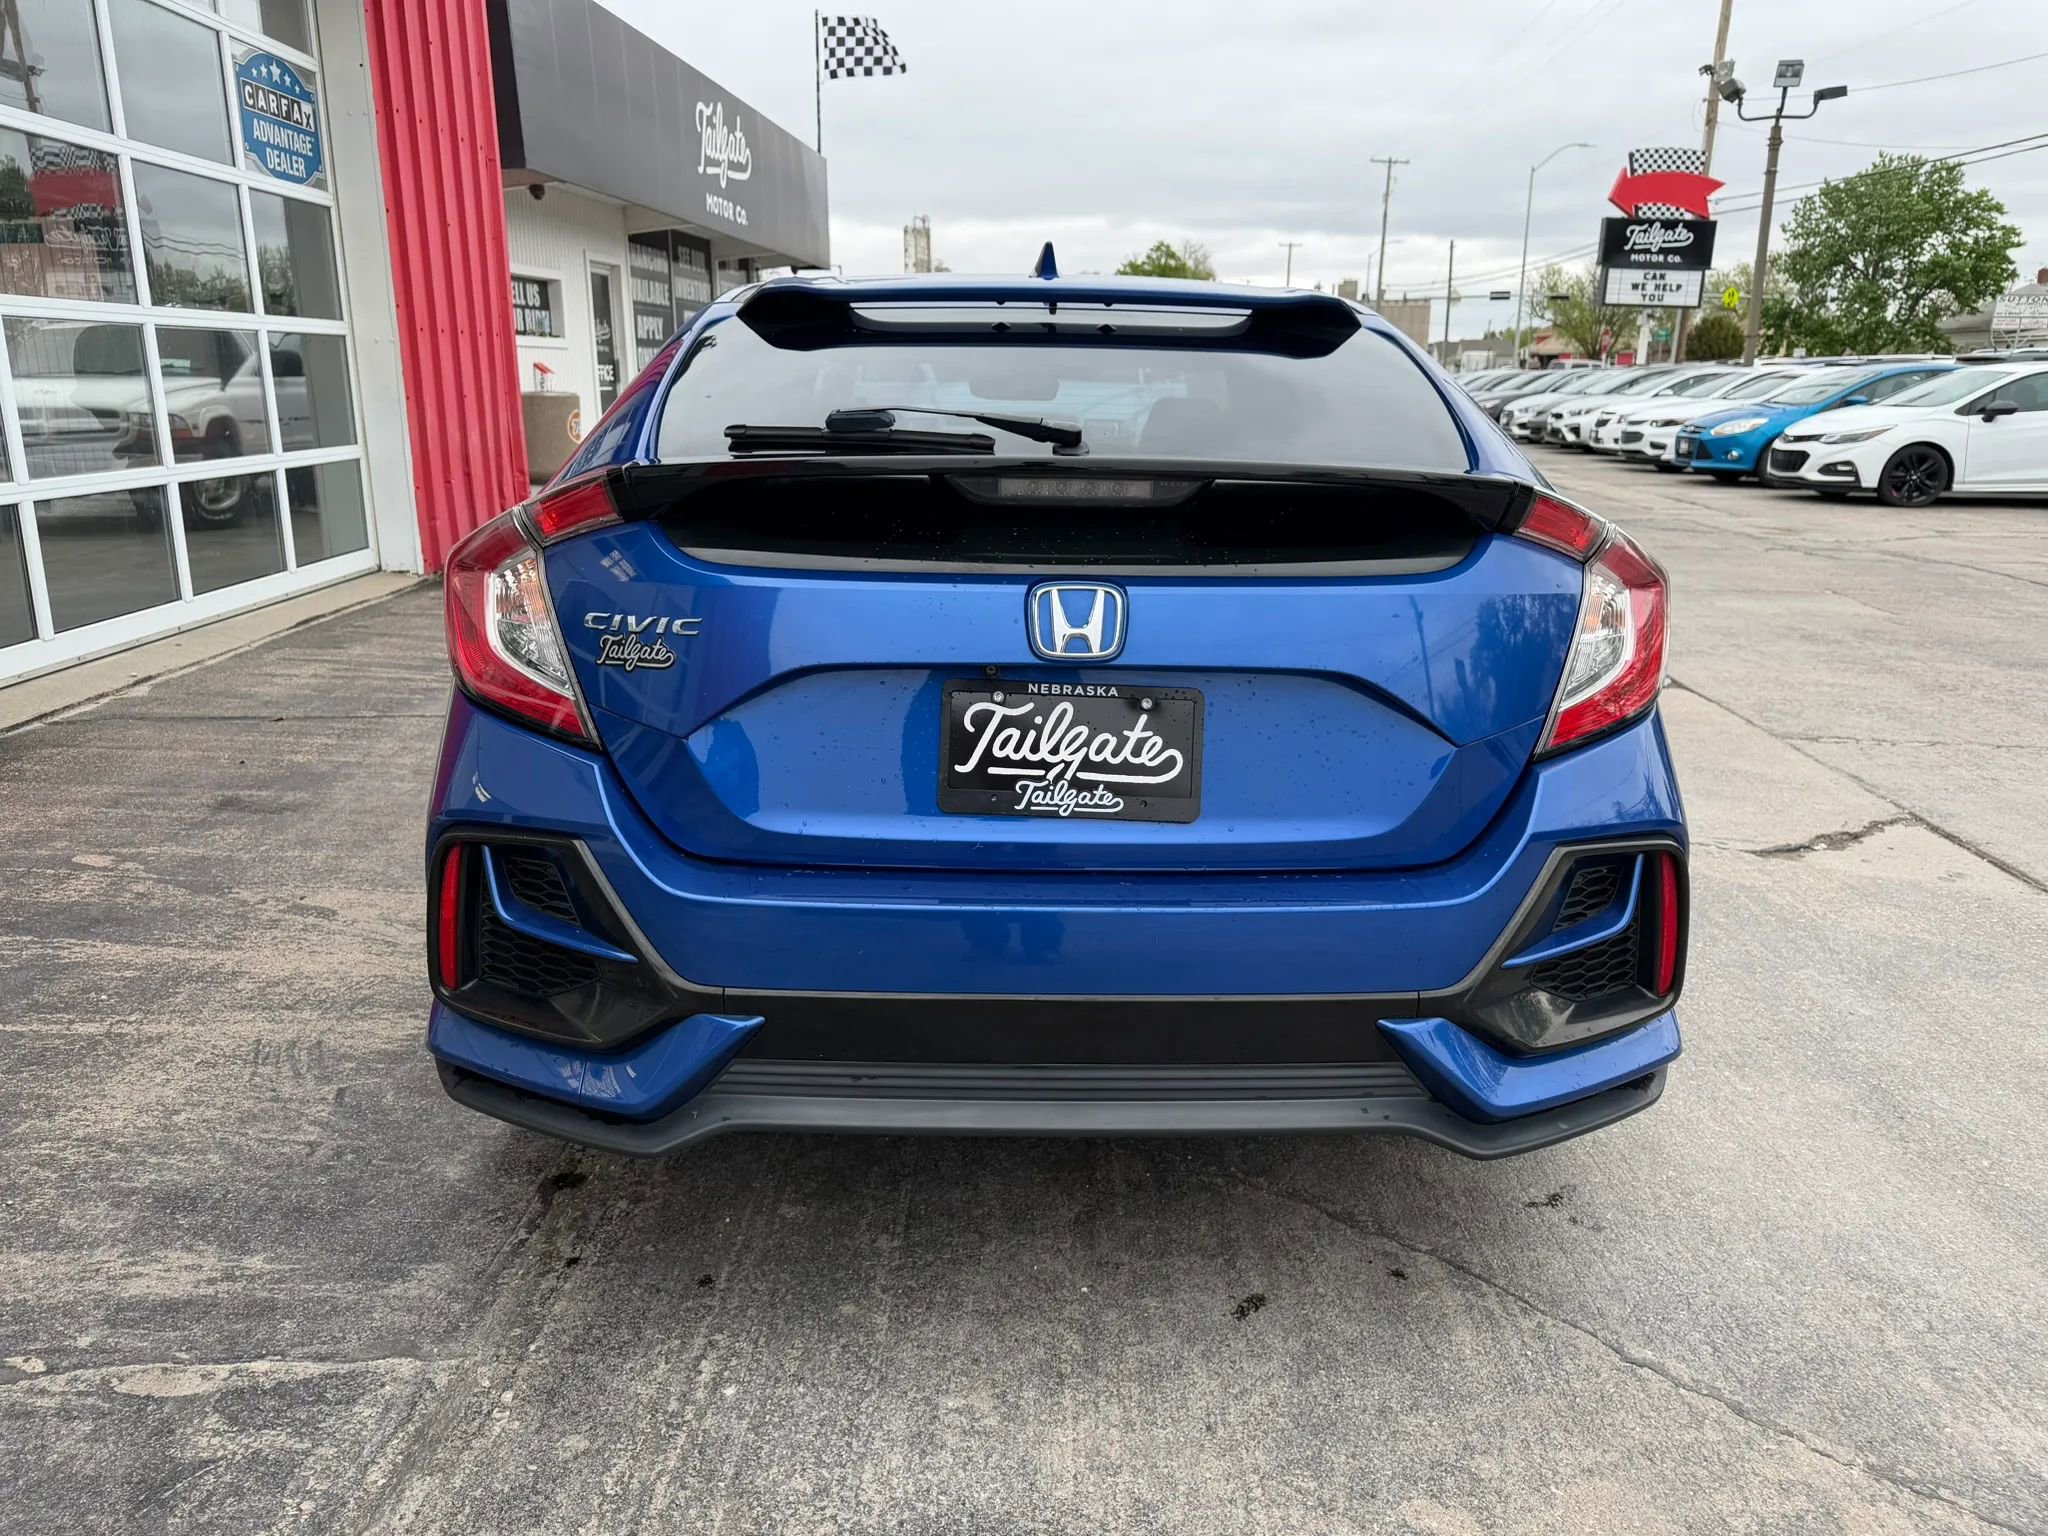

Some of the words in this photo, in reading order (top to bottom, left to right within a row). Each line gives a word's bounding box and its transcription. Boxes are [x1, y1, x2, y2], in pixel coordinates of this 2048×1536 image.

[243, 83, 314, 131] CARFAX
[253, 117, 314, 157] ADVANTAGE
[695, 100, 752, 189] Tailgate
[265, 147, 307, 178] DEALER
[705, 191, 735, 222] MOTOR
[1623, 221, 1695, 253] Tailgate
[1630, 253, 1664, 263] MOTOR
[1631, 282, 1648, 292] WE
[1654, 283, 1683, 293] HELP
[1643, 271, 1667, 281] CAN
[526, 282, 541, 308] US
[1641, 293, 1665, 303] YOU
[636, 314, 664, 341] APPLY
[583, 612, 703, 636] CIVIC
[596, 633, 676, 672] Tailgate
[1027, 683, 1120, 699] NEBRASKA
[954, 701, 1184, 785] Tailgate
[1014, 779, 1125, 817] Tailgate
